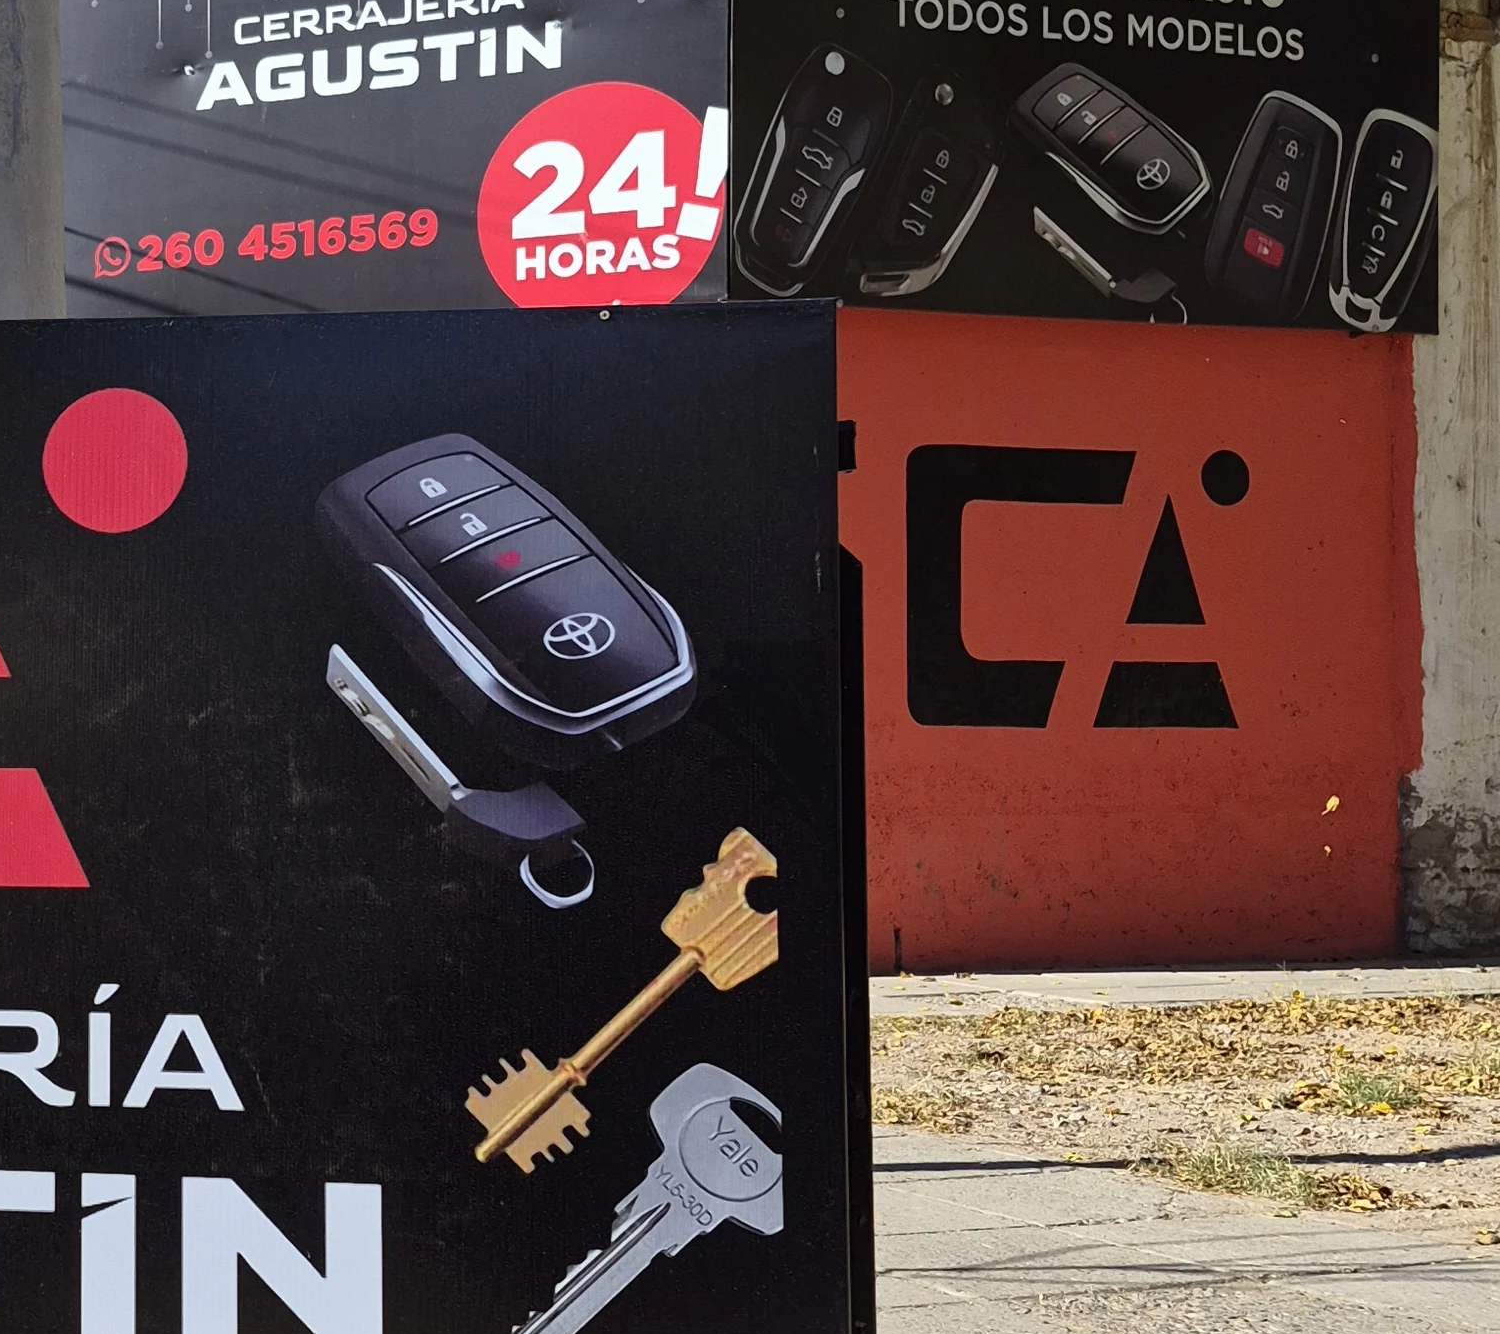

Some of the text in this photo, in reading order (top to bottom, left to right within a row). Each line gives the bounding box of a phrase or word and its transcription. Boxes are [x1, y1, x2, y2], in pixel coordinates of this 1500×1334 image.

[1042, 5, 1114, 45] LOS
[1127, 13, 1305, 61] MODELOS
[137, 208, 438, 272] 260 4516569
[514, 234, 682, 281] HORAS
[709, 1114, 759, 1177] Yale
[655, 1164, 713, 1227] YL5-30D
